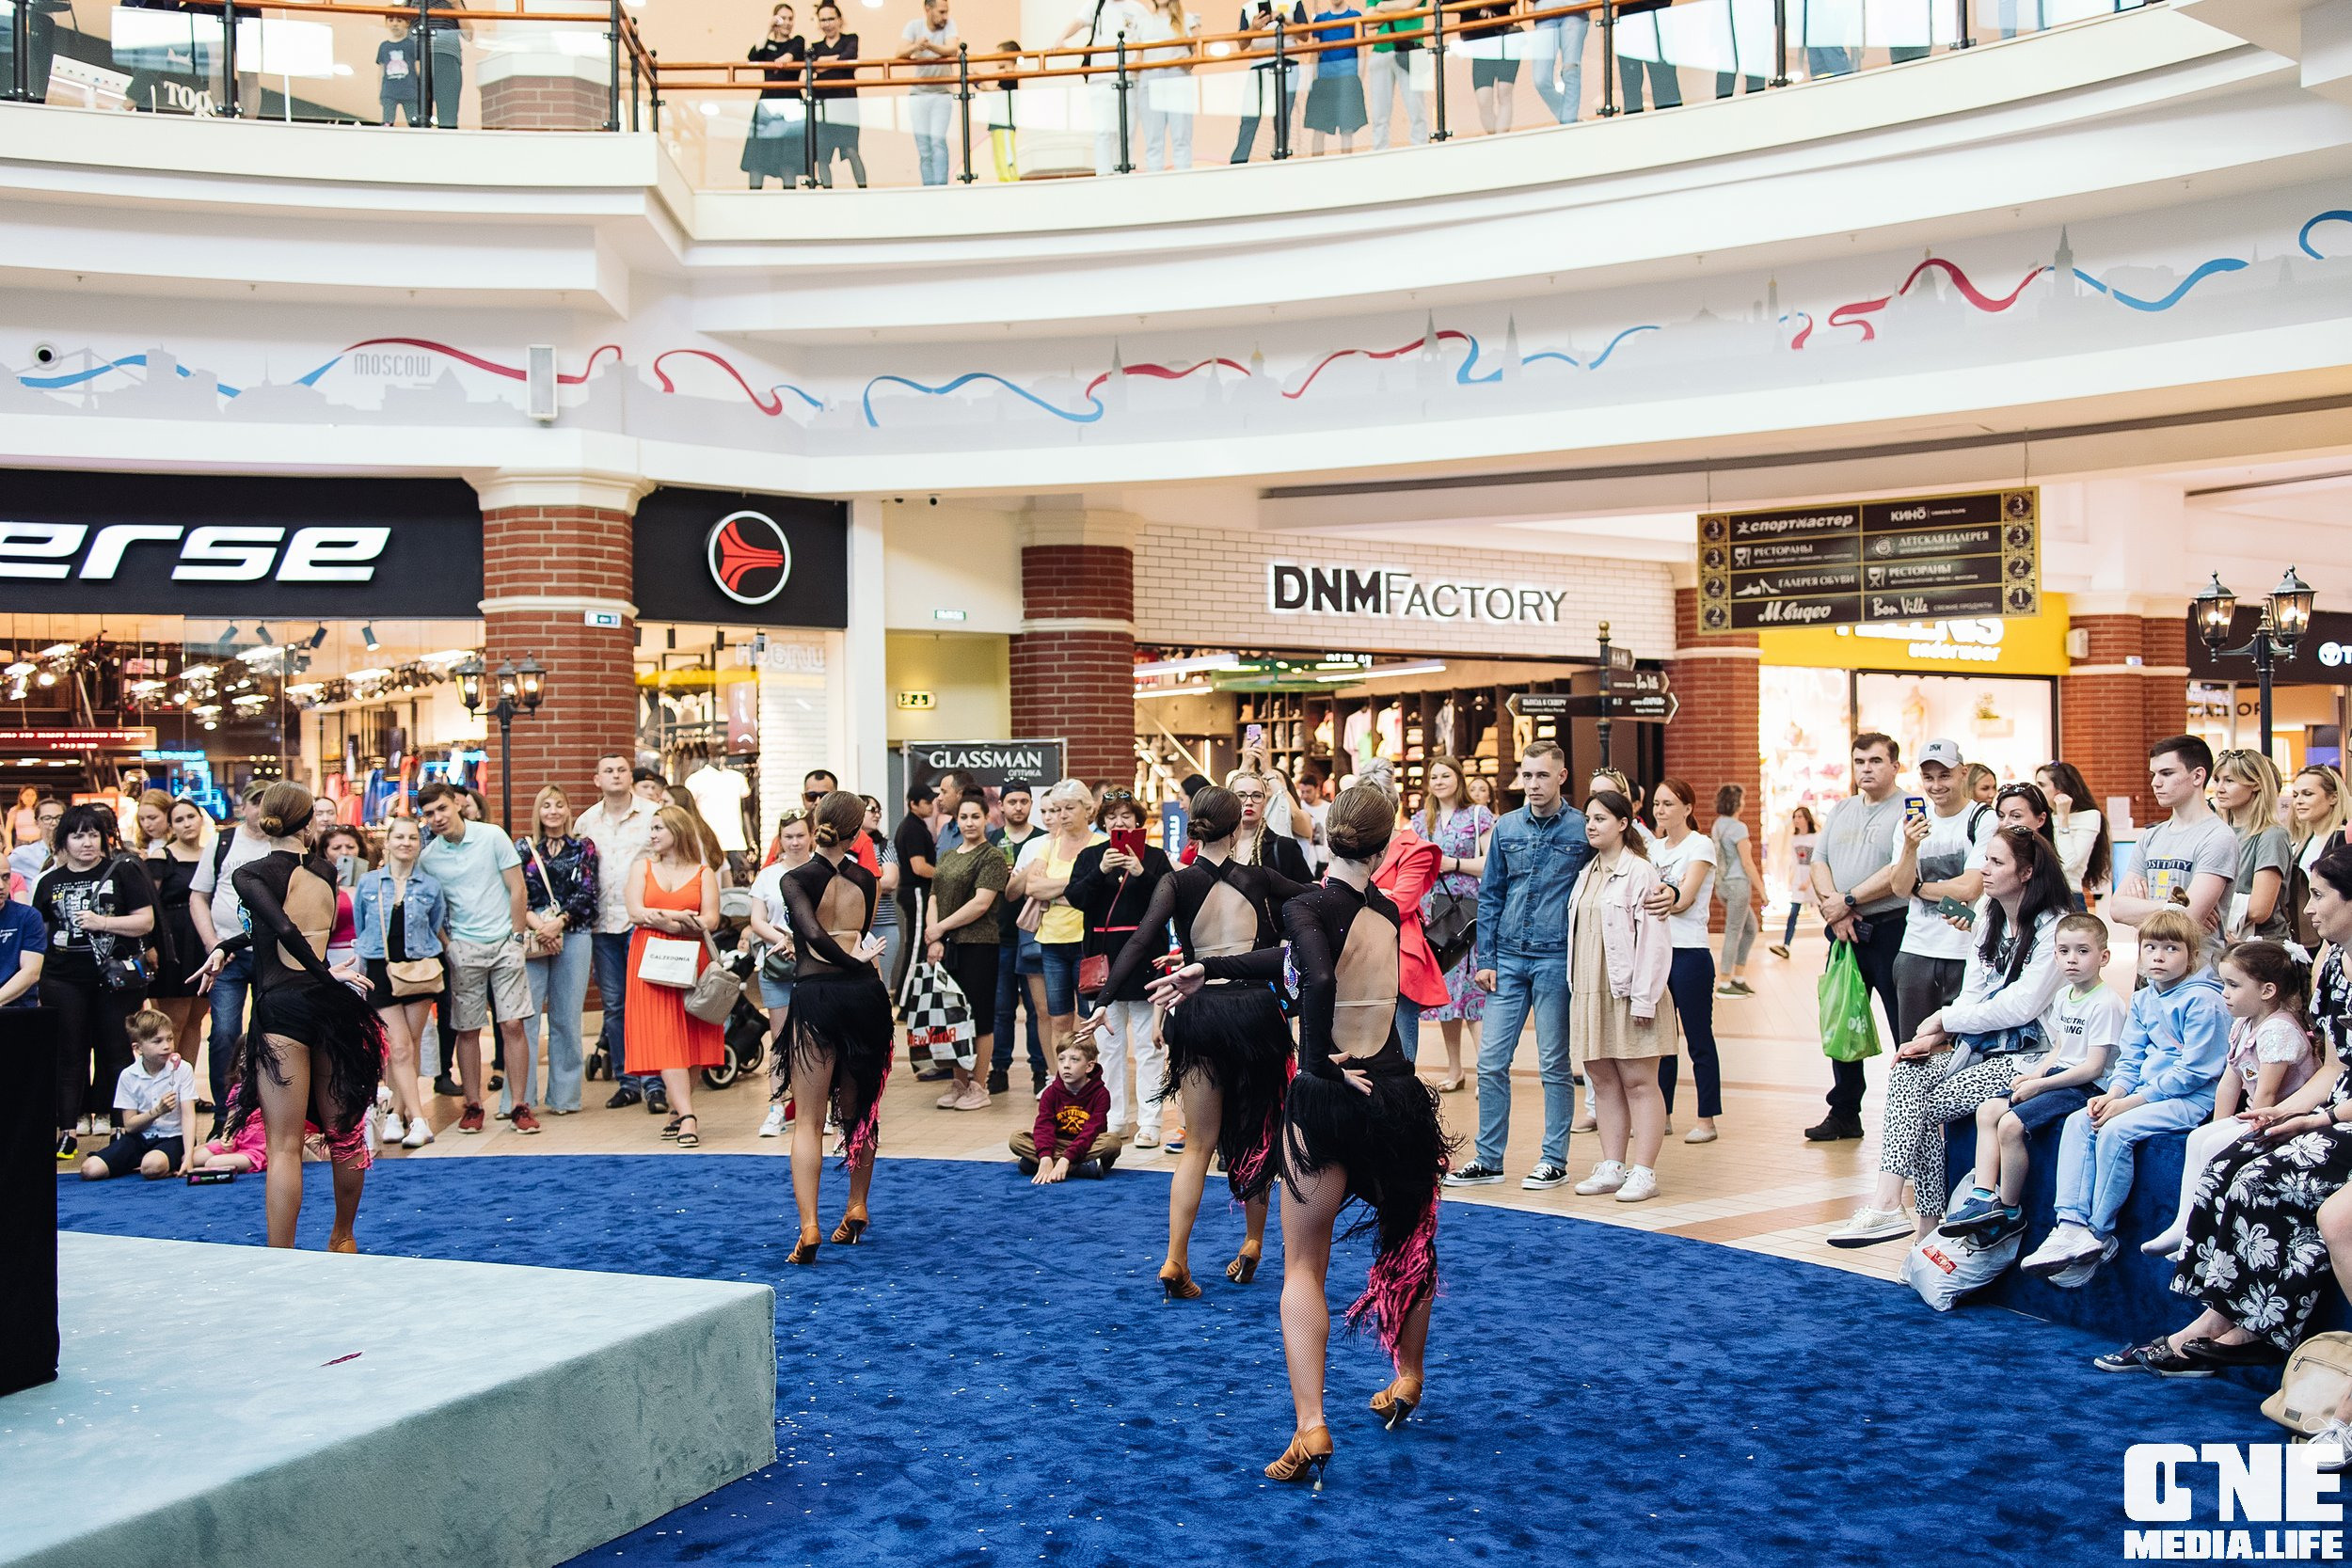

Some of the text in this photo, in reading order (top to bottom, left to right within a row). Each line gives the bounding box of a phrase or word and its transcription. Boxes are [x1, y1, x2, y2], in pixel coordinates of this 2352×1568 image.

[354, 353, 431, 377] MOSCOW
[1890, 509, 1927, 522] КИНО
[1750, 515, 1853, 532] спортмастер
[1899, 531, 1989, 546] ДЕТСКАЯ ГАЛЕРЕЯ
[0, 522, 391, 581] erse
[1754, 544, 1813, 557] РЕСТОРАНЫ
[1889, 564, 1951, 577] РЕСТОРАНЫ
[1778, 575, 1854, 588] ГАЛЕРЕЯ ОБУВИ
[1872, 596, 1929, 617] Bon Ville
[929, 751, 1041, 768] GLASSMAN
[2145, 860, 2191, 871] OSITIVITY
[649, 954, 690, 962] CALZEDONIA
